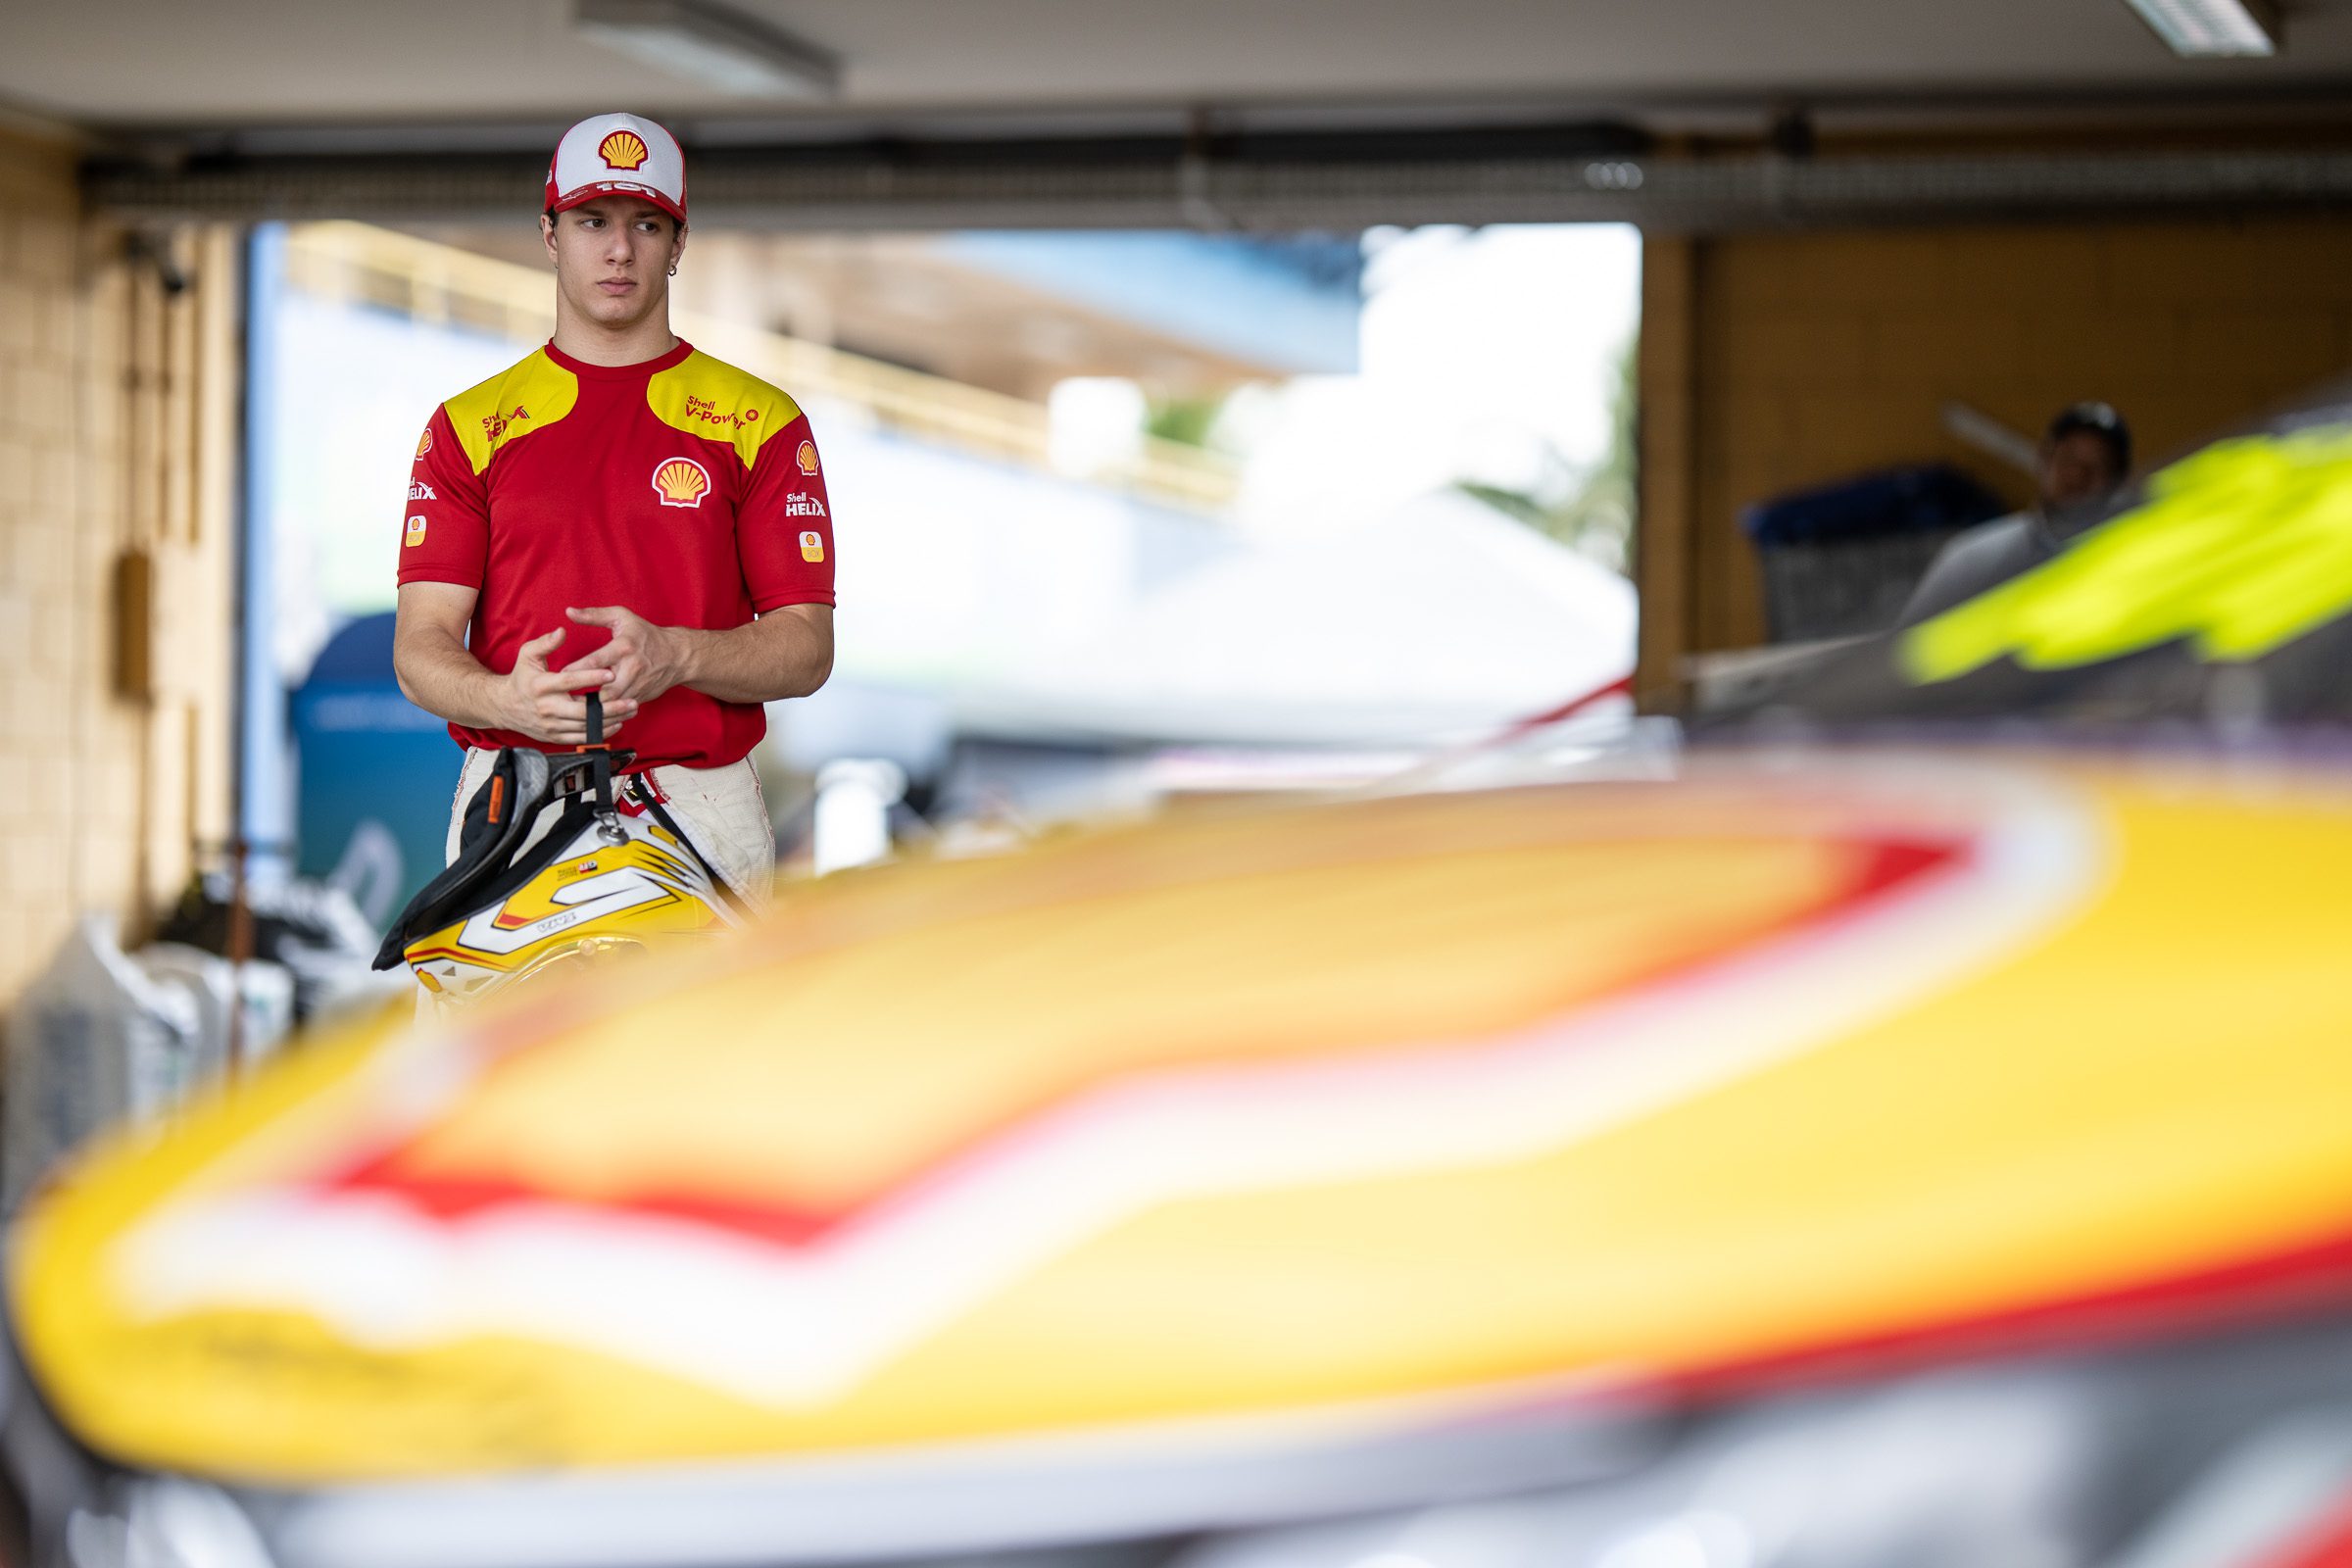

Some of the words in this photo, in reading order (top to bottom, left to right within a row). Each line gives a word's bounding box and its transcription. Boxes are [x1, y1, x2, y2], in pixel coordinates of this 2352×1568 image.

[688, 395, 716, 411] Shell
[686, 405, 746, 430] V-Power
[786, 492, 807, 504] Shell
[786, 497, 826, 517] HELIX
